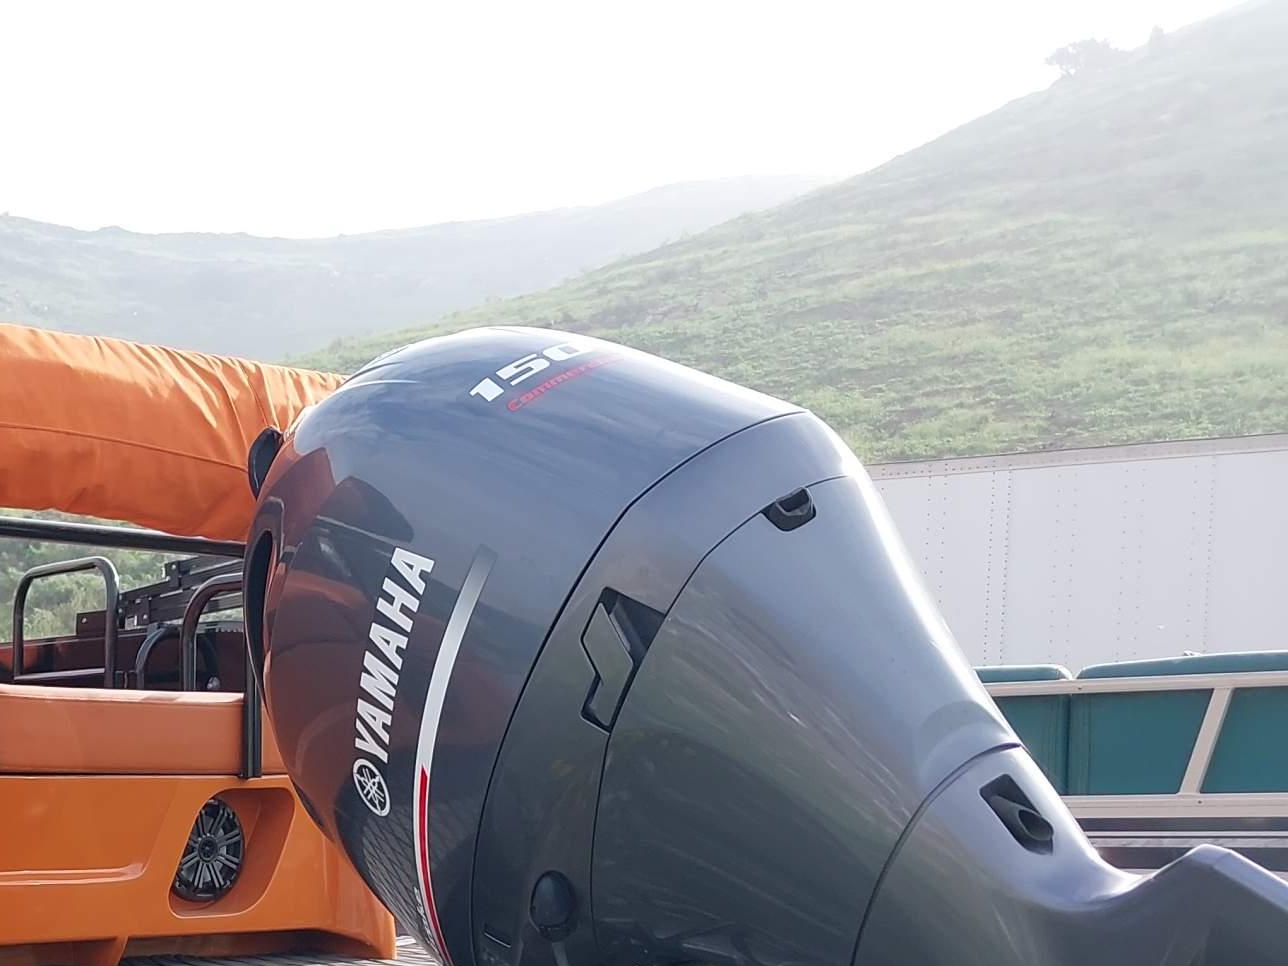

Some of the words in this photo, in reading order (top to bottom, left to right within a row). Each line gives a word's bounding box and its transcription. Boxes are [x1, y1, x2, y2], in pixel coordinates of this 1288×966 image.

[469, 343, 590, 402] 150
[507, 352, 623, 412] Commer
[354, 546, 435, 765] YAMAHA
